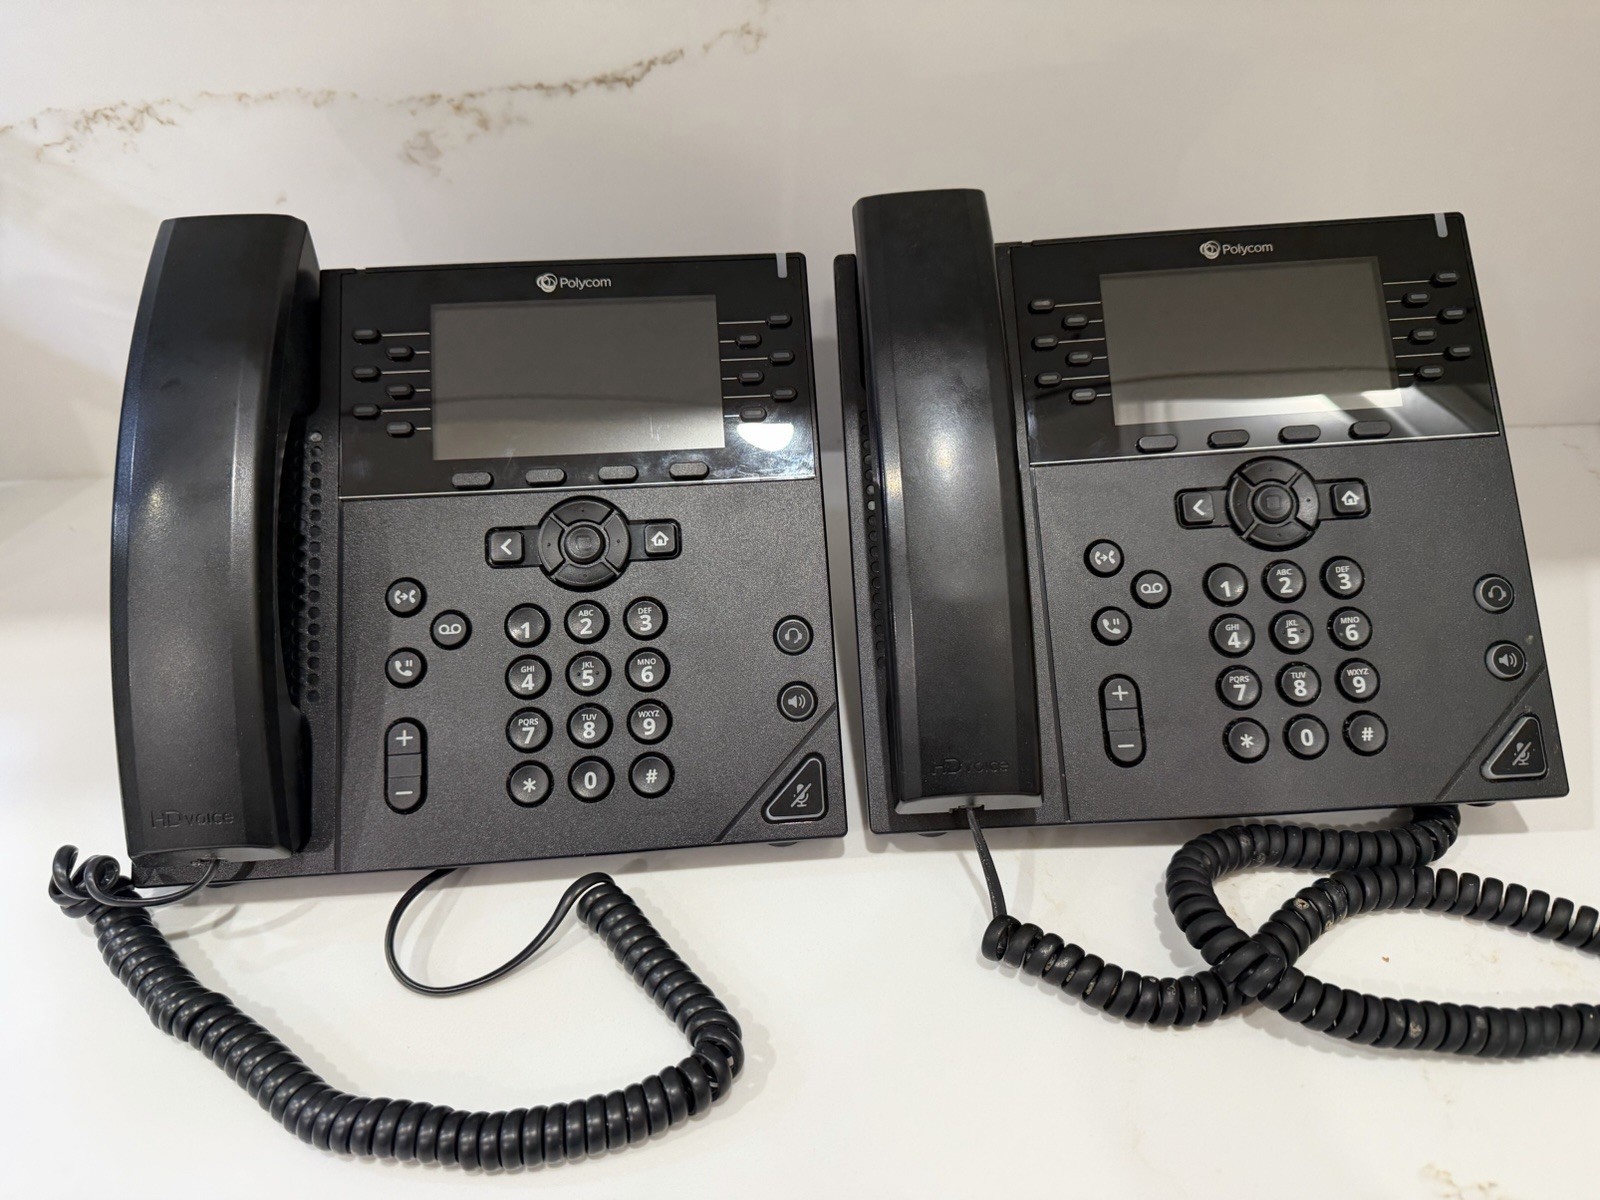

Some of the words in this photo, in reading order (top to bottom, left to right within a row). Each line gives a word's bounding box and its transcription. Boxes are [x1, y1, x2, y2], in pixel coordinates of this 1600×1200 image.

[1222, 244, 1273, 255] Polycom
[560, 278, 611, 290] Polycom
[1336, 566, 1350, 574] DEF
[1221, 581, 1231, 597] 1
[1279, 577, 1293, 593] 2
[1338, 573, 1352, 589] 3
[579, 618, 592, 634] 2
[640, 615, 652, 631] 3
[1286, 620, 1298, 628] JKL
[1341, 617, 1359, 625] MNO
[520, 622, 529, 638] 1
[1287, 628, 1300, 644] 5
[1346, 624, 1359, 641] 6
[1228, 632, 1241, 648] 4
[581, 662, 594, 670] JKL
[641, 666, 653, 682] 6
[1347, 668, 1369, 676] WXYZ
[521, 674, 534, 690] 4
[582, 669, 594, 686] 5
[1353, 676, 1366, 693] 9
[1234, 684, 1246, 701] 7
[1294, 680, 1307, 696] 8
[519, 718, 538, 727] PQRS
[643, 718, 655, 735] 9
[522, 727, 534, 743] 7
[582, 722, 595, 740] 8
[1301, 729, 1313, 746] 0
[585, 772, 596, 790] 0
